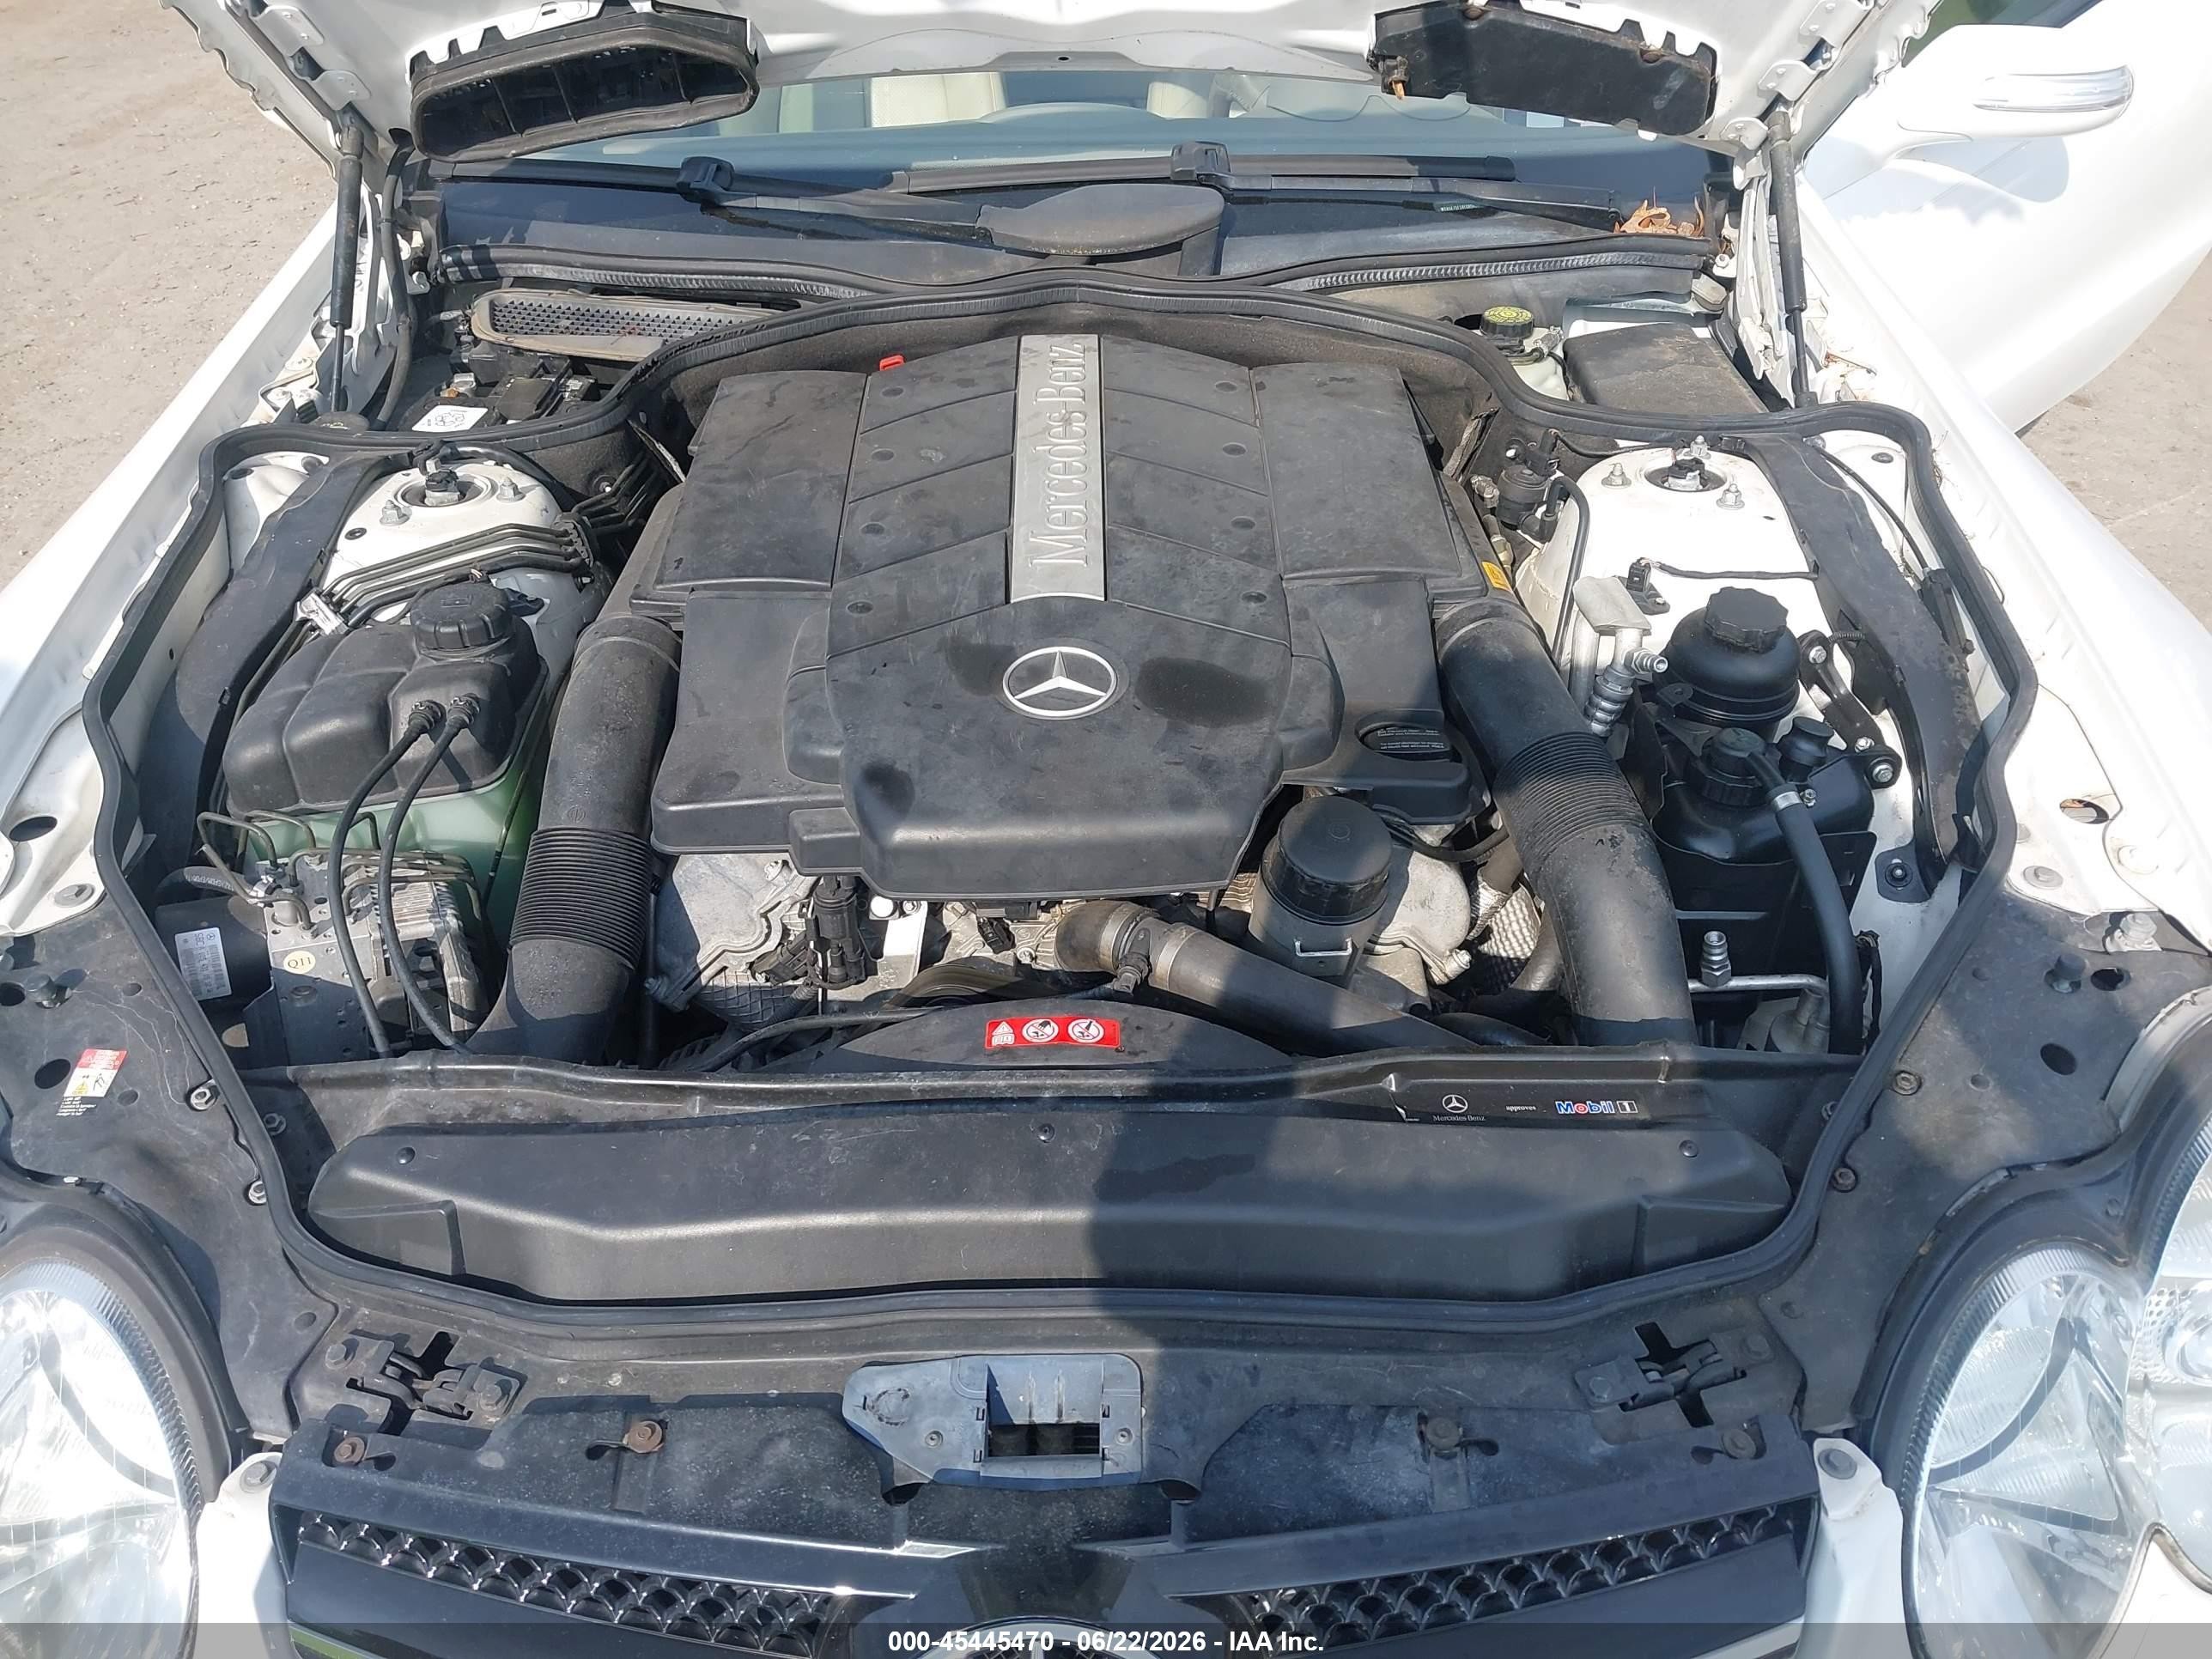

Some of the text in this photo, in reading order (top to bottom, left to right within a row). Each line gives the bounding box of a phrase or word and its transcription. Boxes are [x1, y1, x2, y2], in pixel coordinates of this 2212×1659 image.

[1029, 343, 1088, 568] Mercedes-Benz
[1505, 1104, 1537, 1113] approves
[1555, 1100, 1615, 1115] Mobil
